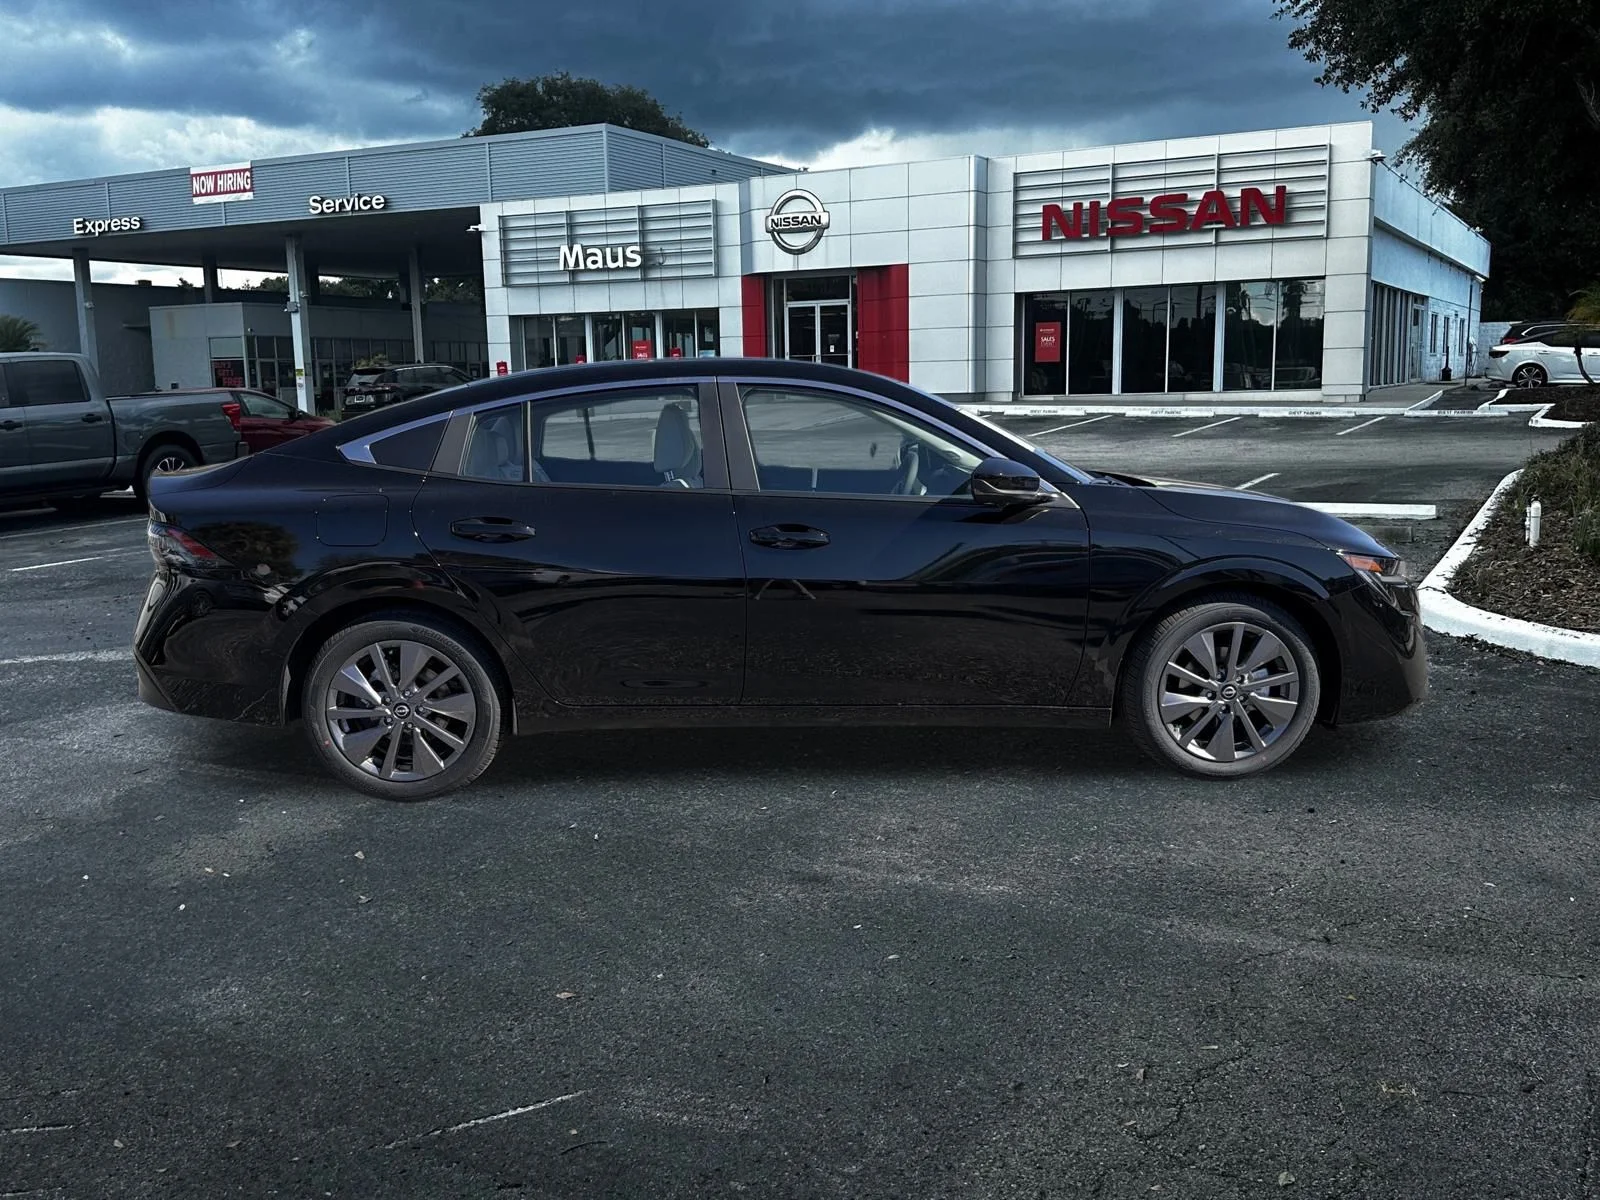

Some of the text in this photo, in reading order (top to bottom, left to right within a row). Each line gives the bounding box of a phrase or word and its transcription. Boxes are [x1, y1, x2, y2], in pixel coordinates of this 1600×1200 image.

[192, 171, 251, 195] NOW HIRING
[309, 193, 385, 215] Service
[1042, 185, 1287, 241] NISSAN
[73, 216, 141, 237] Express
[770, 214, 822, 228] NISSAN
[559, 243, 642, 271] Maus
